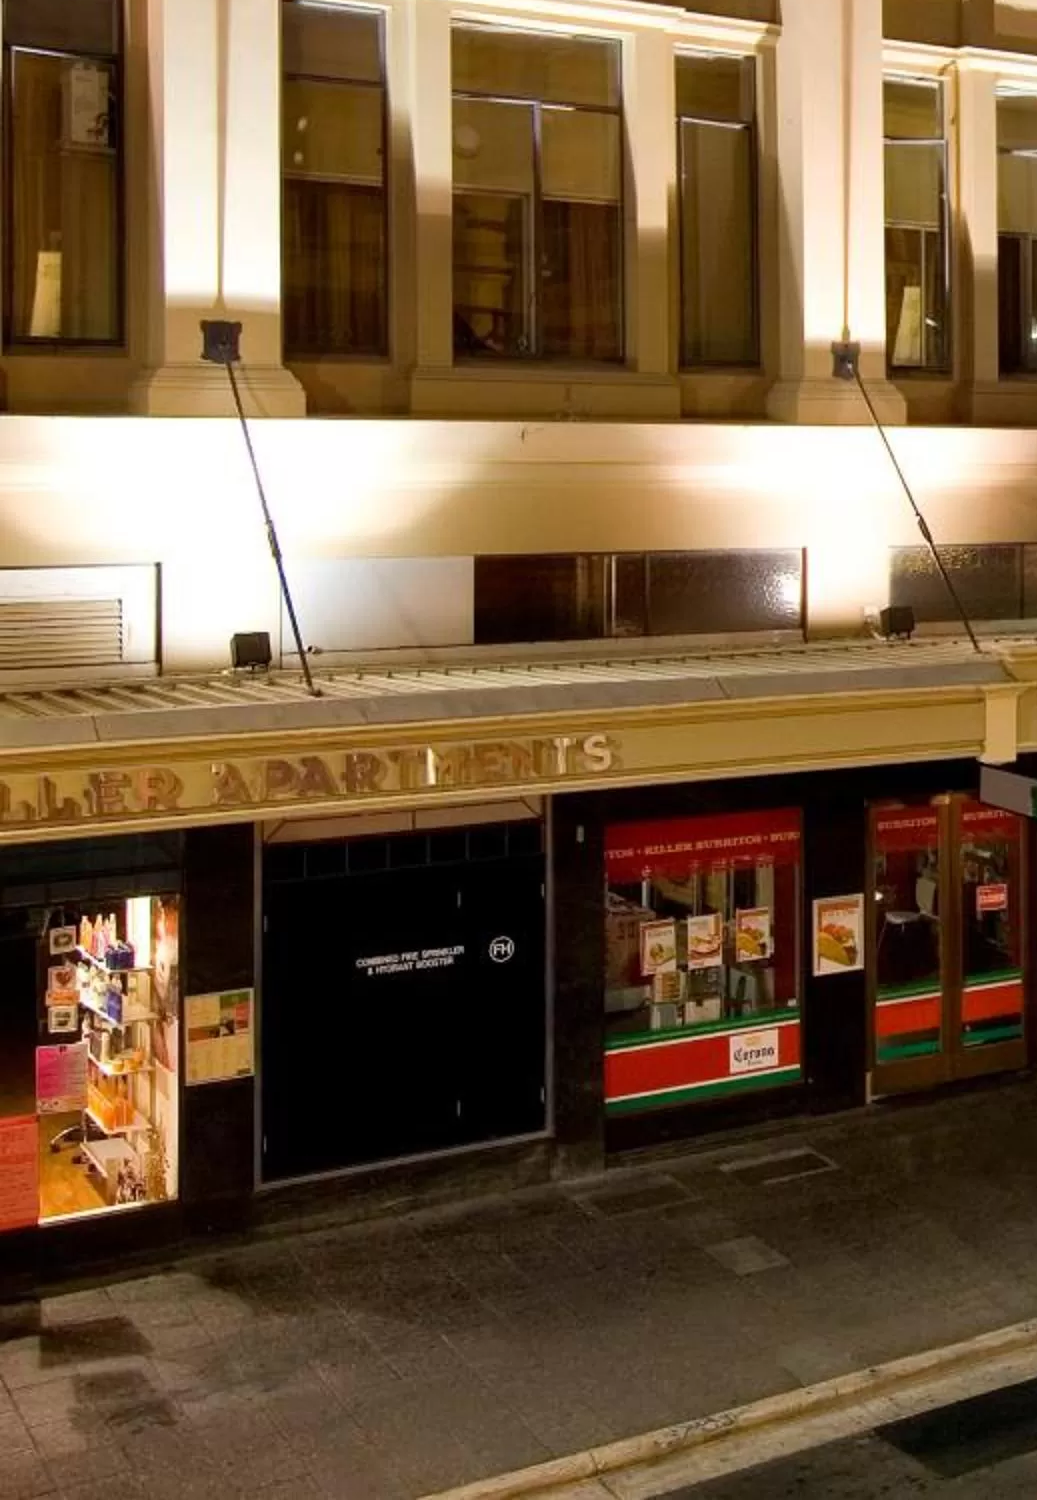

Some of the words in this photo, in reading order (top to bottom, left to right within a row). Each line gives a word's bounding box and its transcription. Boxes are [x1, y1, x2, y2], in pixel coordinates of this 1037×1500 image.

[209, 732, 613, 805] APARTMENTS
[643, 841, 693, 856] KILLER
[695, 835, 763, 850] BURRITOS
[733, 1047, 775, 1063] Corona
